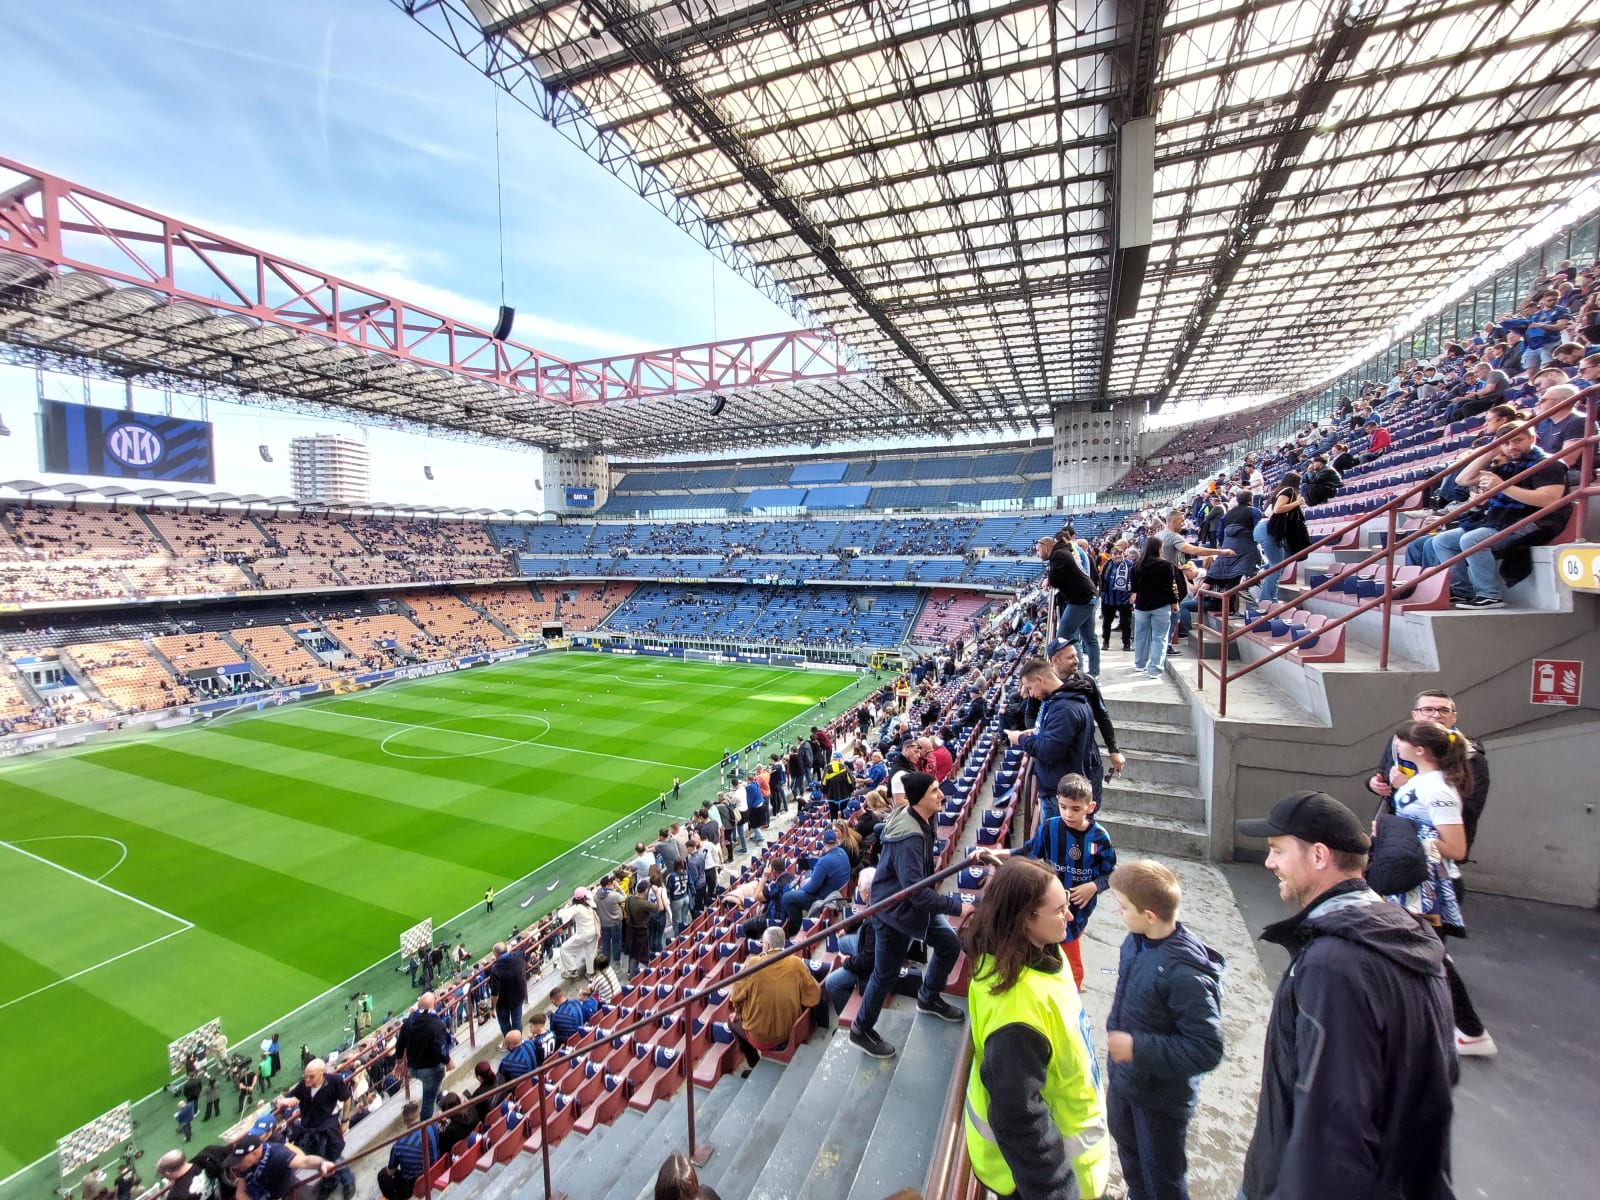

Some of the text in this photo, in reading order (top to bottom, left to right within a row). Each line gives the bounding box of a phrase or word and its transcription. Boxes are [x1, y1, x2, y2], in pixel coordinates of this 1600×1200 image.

[1567, 560, 1579, 575] 06
[1055, 863, 1093, 875] betsson
[542, 1038, 556, 1060] 10
